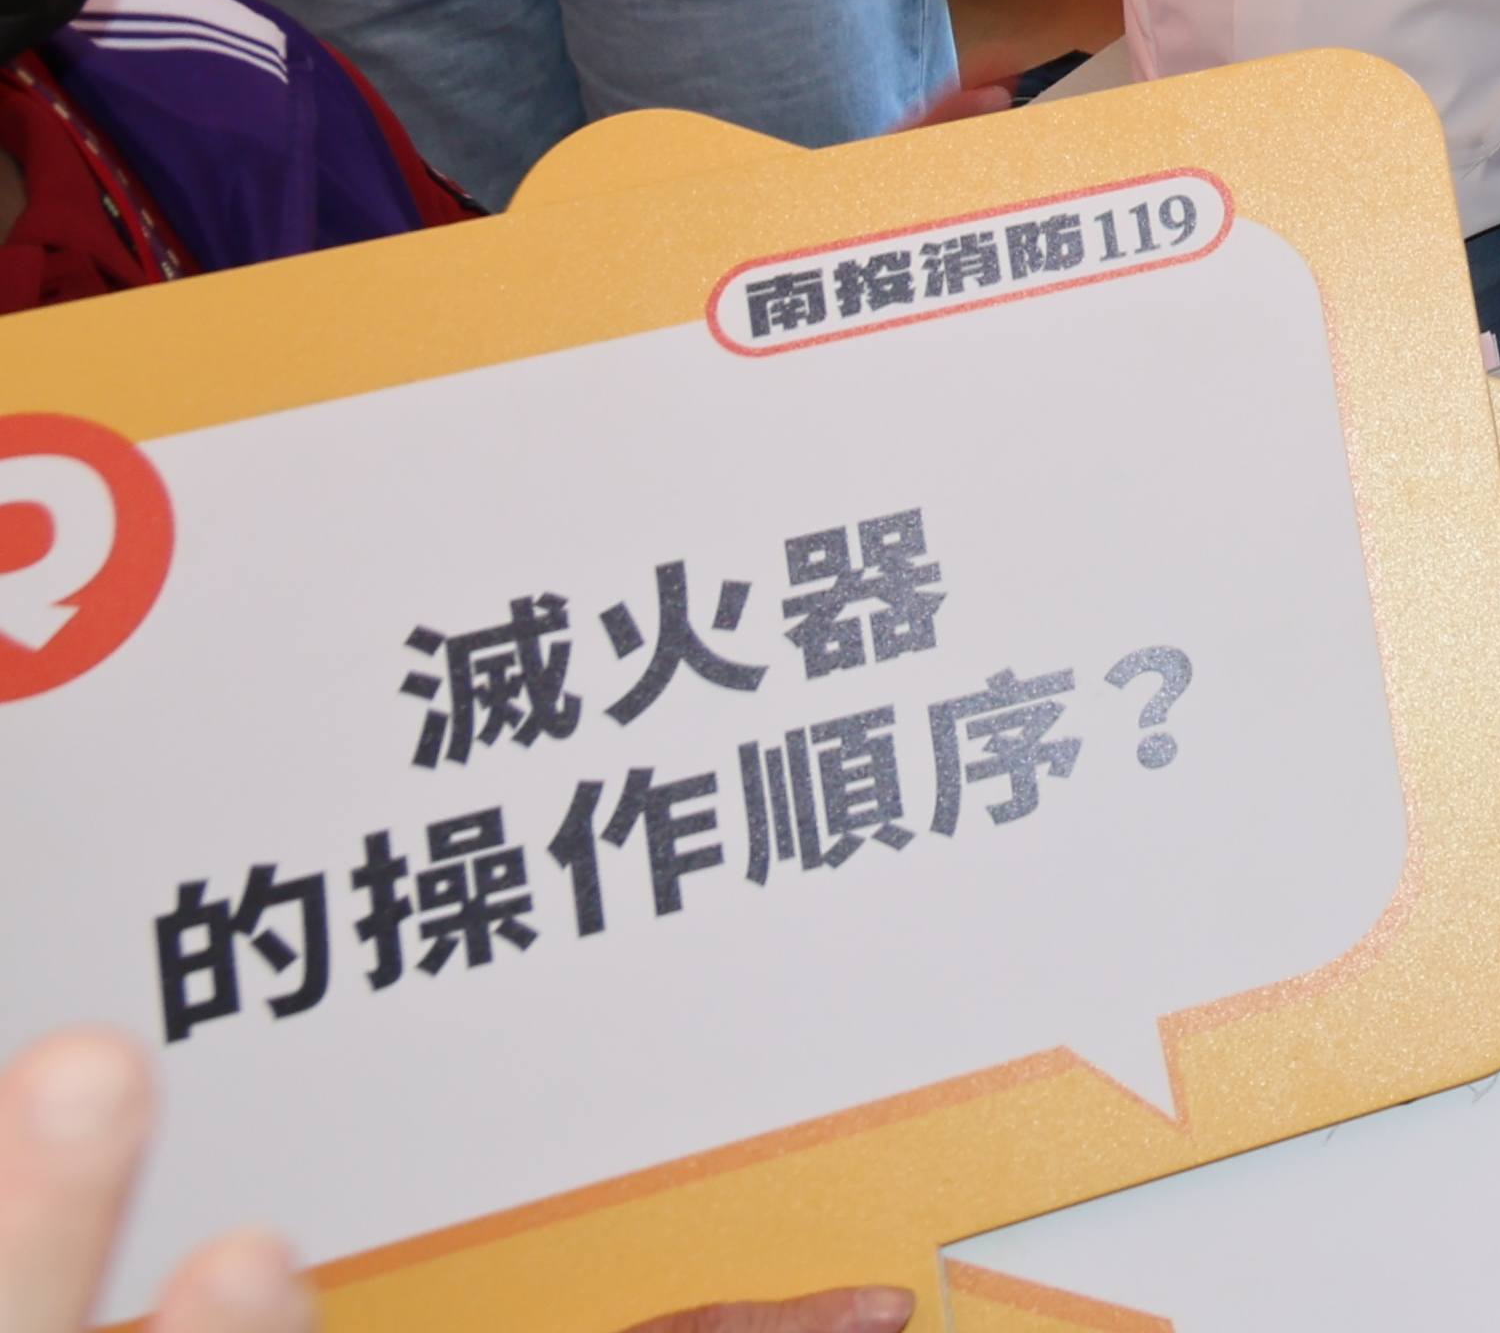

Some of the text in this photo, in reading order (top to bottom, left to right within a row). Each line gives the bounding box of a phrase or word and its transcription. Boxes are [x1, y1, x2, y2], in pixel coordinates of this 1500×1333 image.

[743, 193, 1201, 340] 南投消防119
[400, 505, 950, 773] 滅火器
